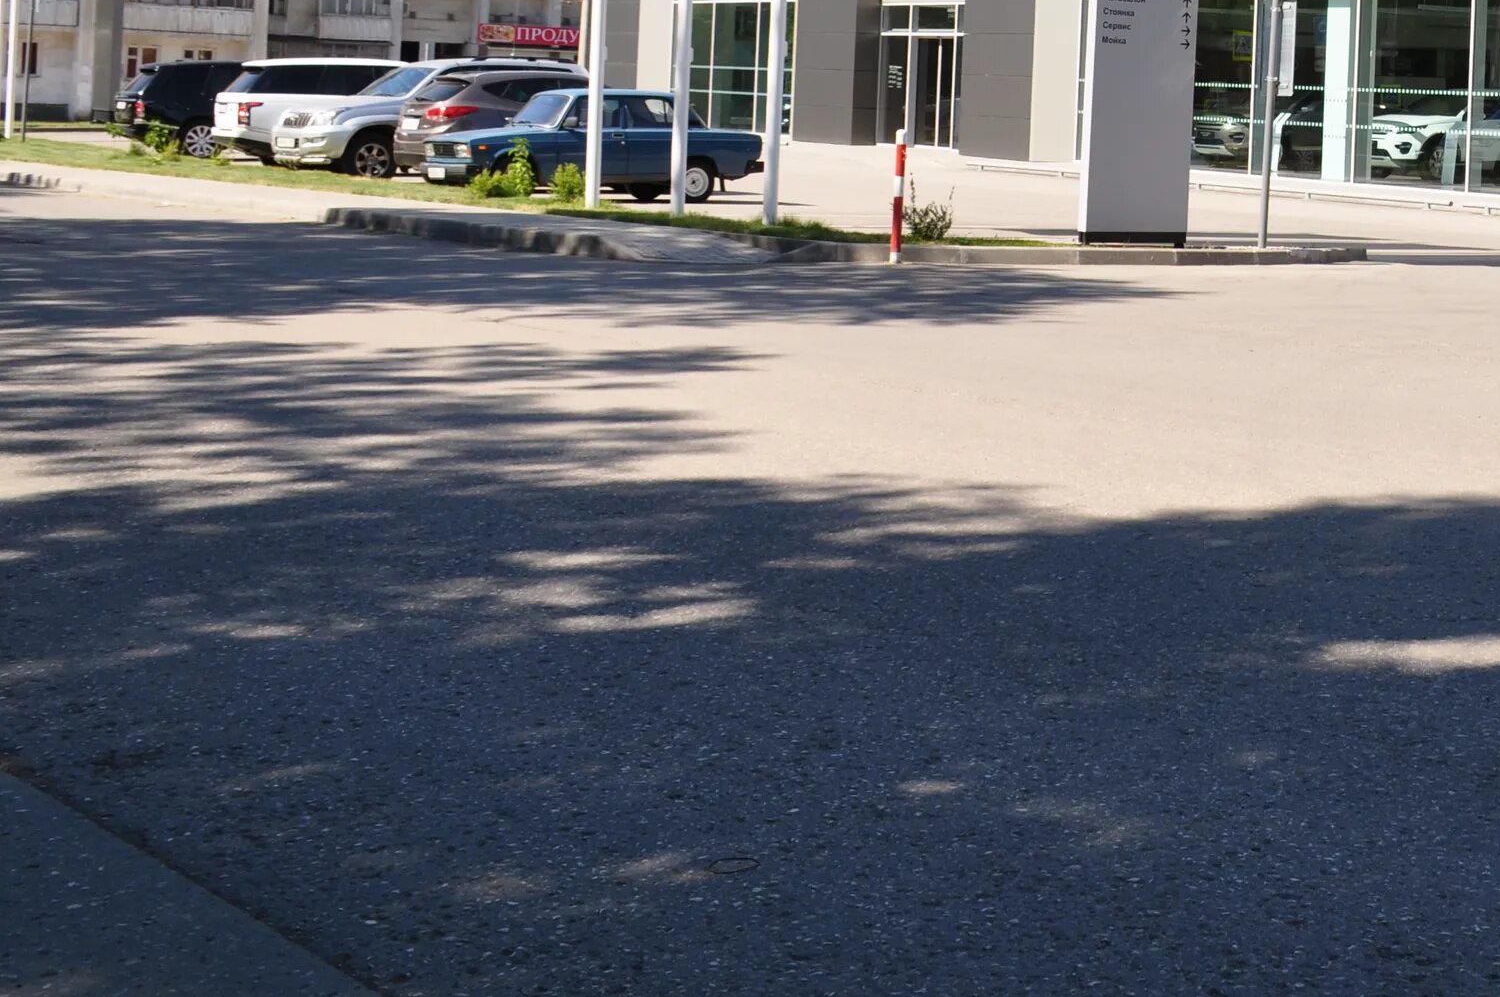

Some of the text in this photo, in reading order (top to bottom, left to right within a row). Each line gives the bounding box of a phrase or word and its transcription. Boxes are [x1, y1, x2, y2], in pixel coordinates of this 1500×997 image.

[1103, 7, 1135, 17] Стоянка
[1102, 21, 1132, 31] Сервис
[516, 27, 580, 44] ПРОДУ
[1101, 35, 1127, 45] Мойка
